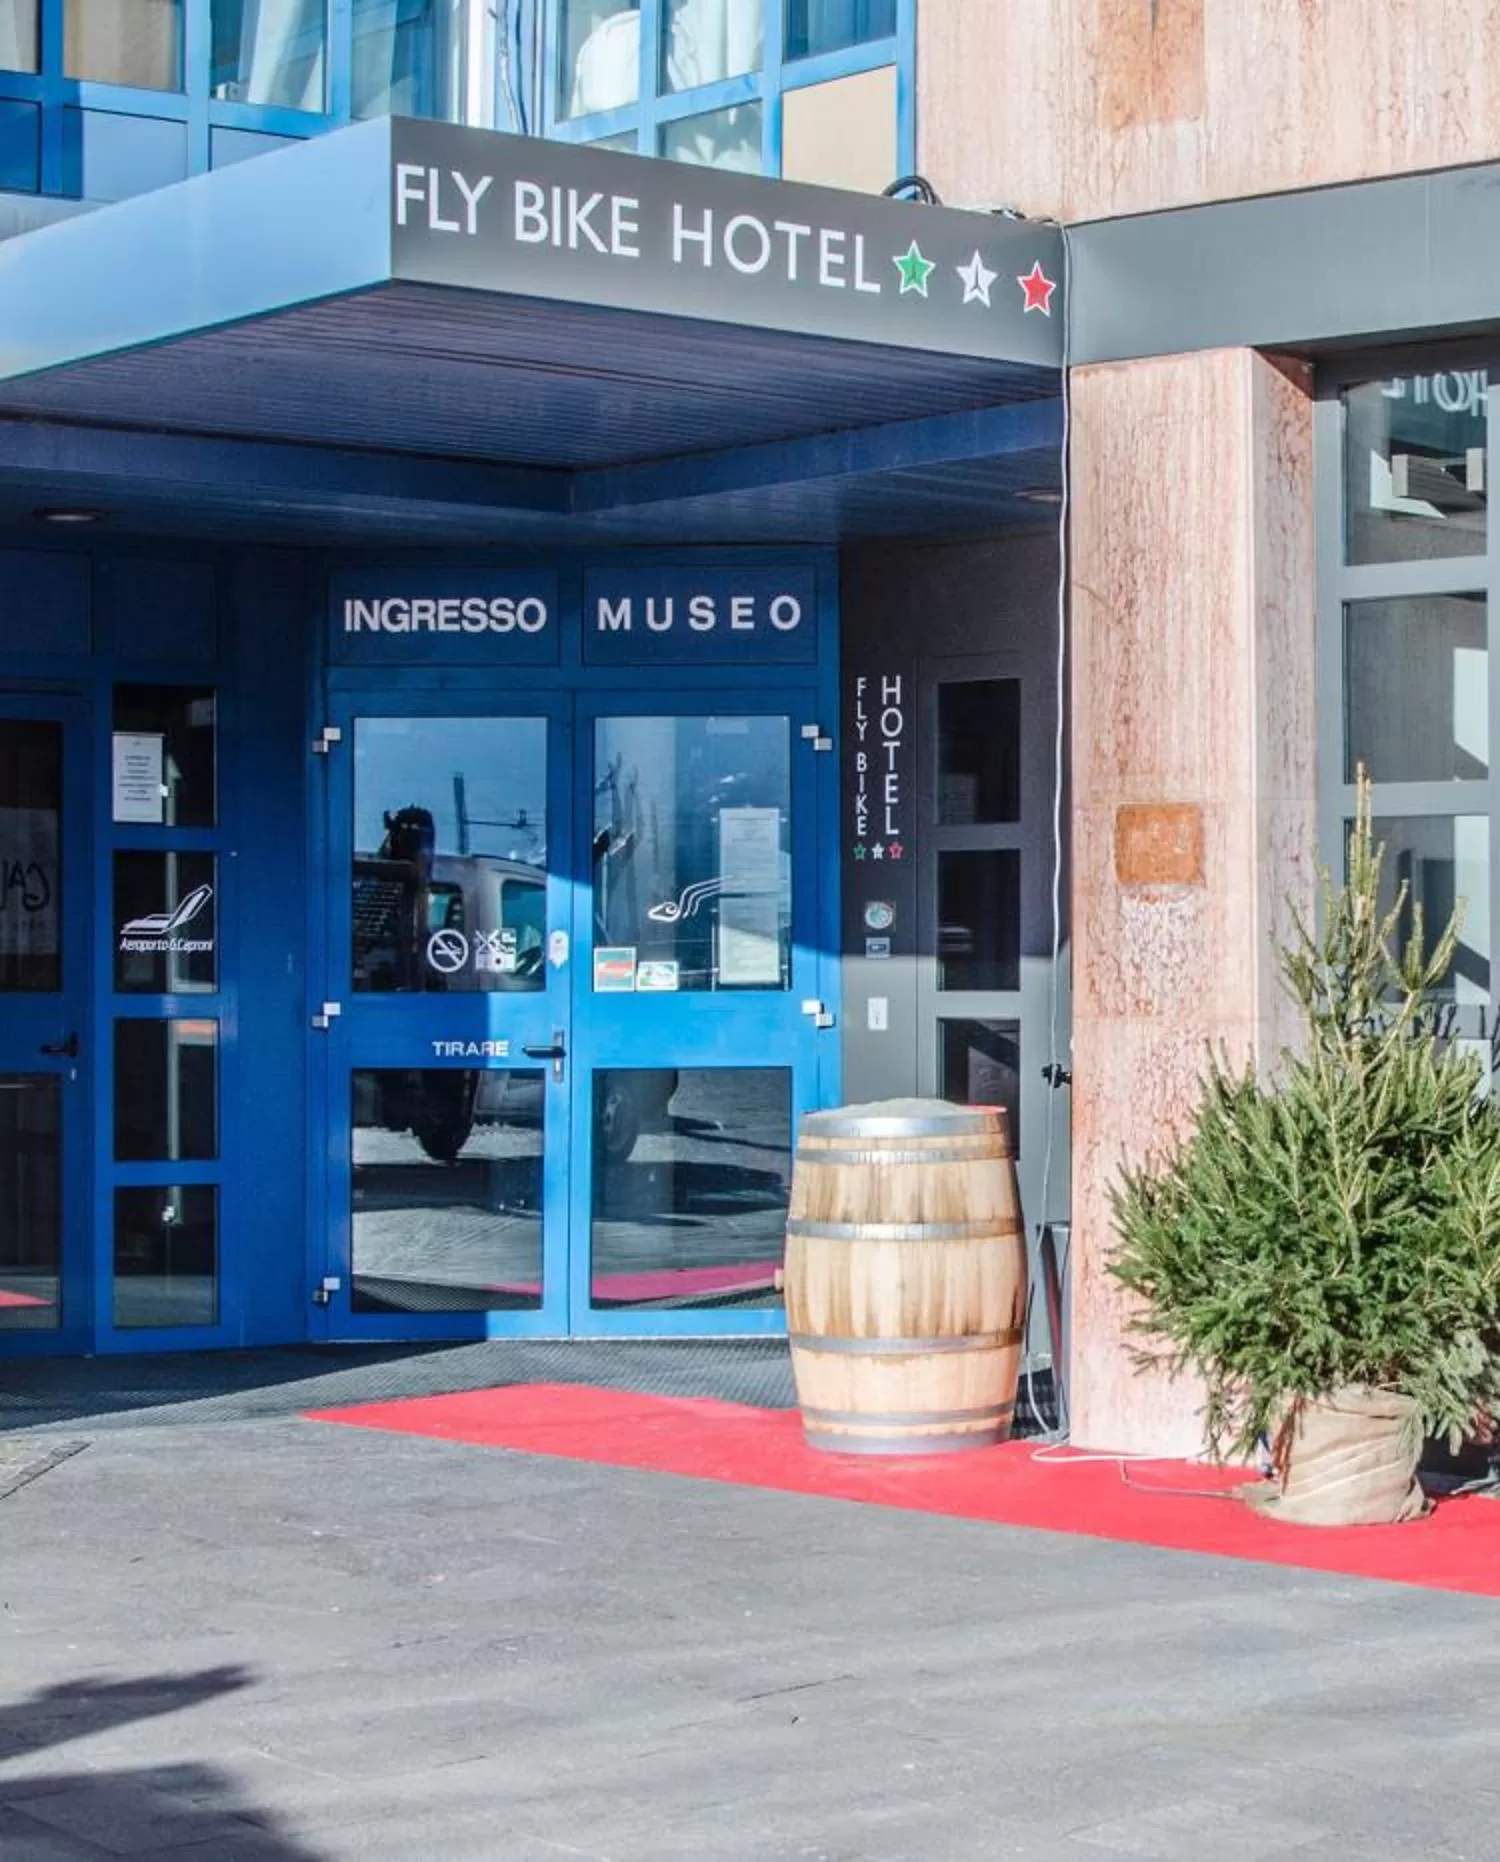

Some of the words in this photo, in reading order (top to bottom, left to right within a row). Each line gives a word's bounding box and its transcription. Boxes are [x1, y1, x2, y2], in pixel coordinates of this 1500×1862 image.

[395, 162, 494, 236] FLY
[513, 180, 641, 258] BIKE
[673, 202, 881, 294] HOTEL
[344, 596, 548, 633] INGRESSO
[597, 594, 801, 631] MUSEO
[856, 677, 867, 741] FLY
[880, 674, 904, 836] HOTEL
[856, 751, 869, 836] BIKE
[432, 1040, 510, 1057] TIRARE
